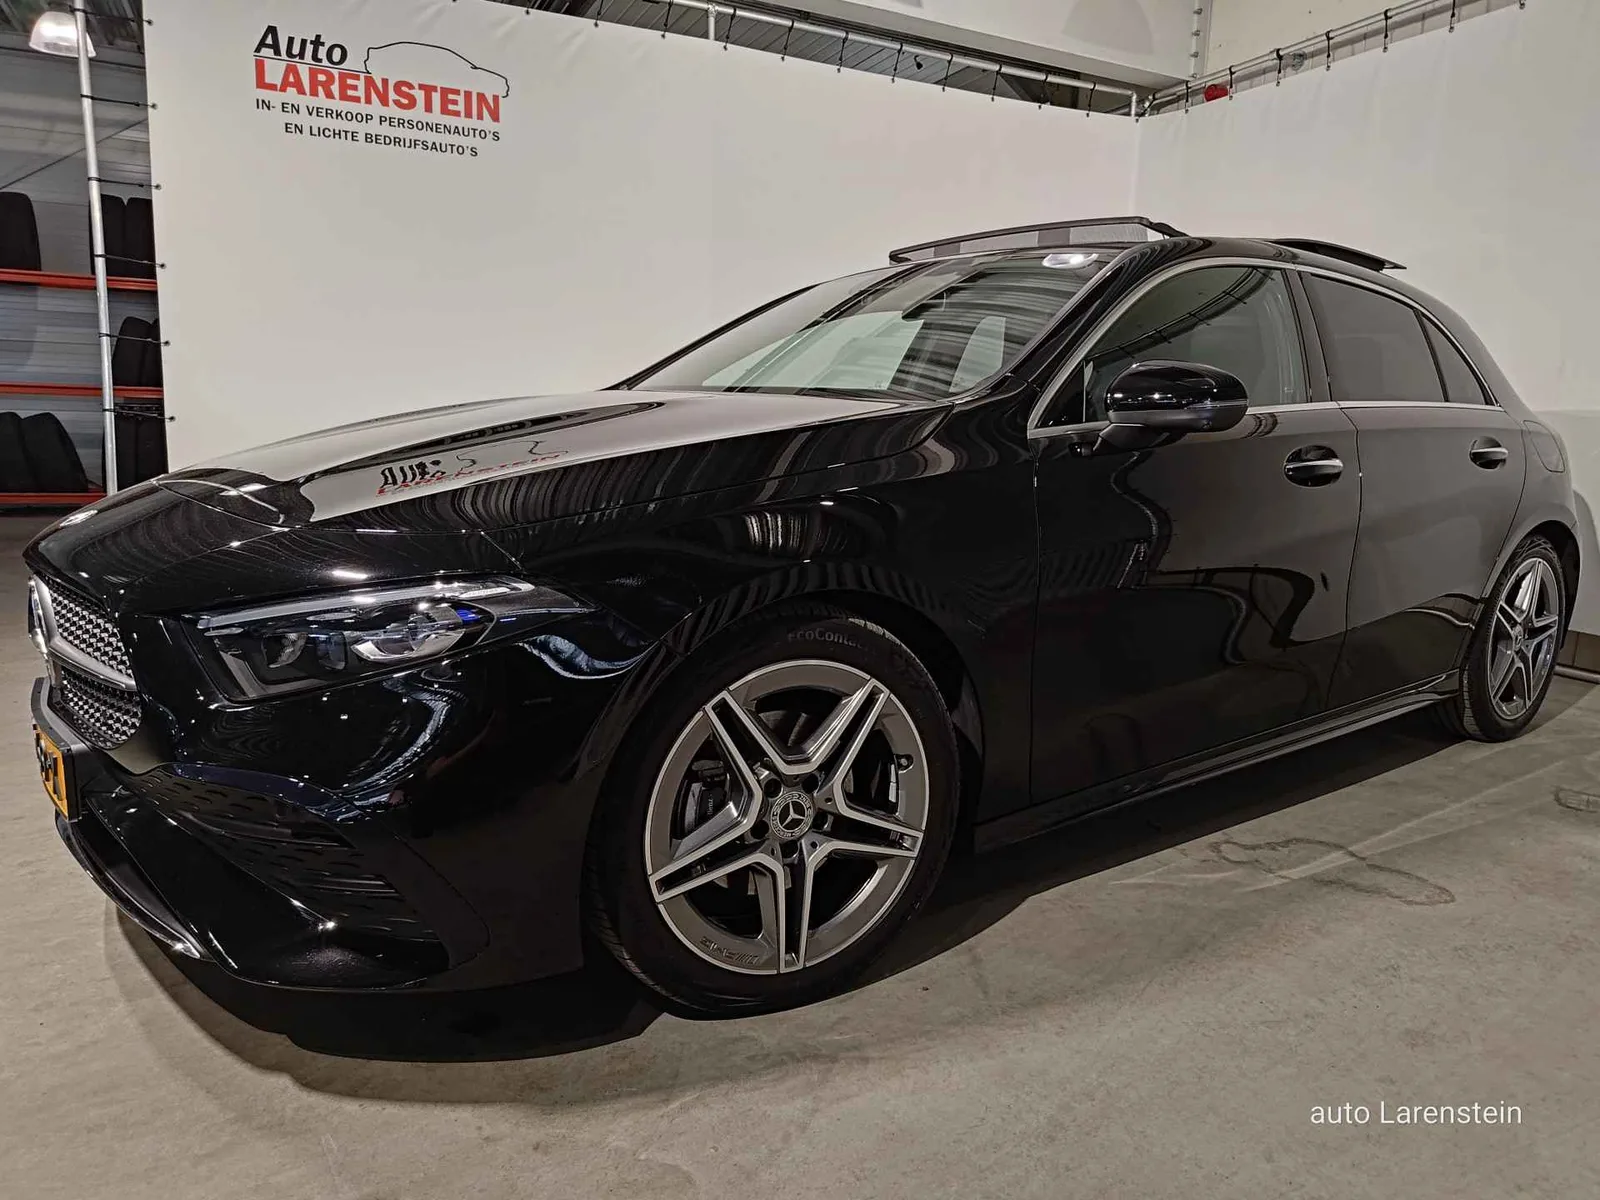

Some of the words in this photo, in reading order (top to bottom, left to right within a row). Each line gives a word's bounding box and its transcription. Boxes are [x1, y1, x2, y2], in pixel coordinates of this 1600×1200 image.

[253, 25, 348, 66] Auto
[254, 58, 501, 123] LARENSTEIN
[255, 98, 276, 111] IN-
[281, 102, 301, 115] EN
[306, 105, 374, 125] VERKOOP
[379, 115, 500, 142] PERSONENAUTO'S
[284, 122, 304, 136] EN
[309, 125, 359, 142] LICHTE
[364, 132, 478, 157] BEDRIJFSAUTO'S
